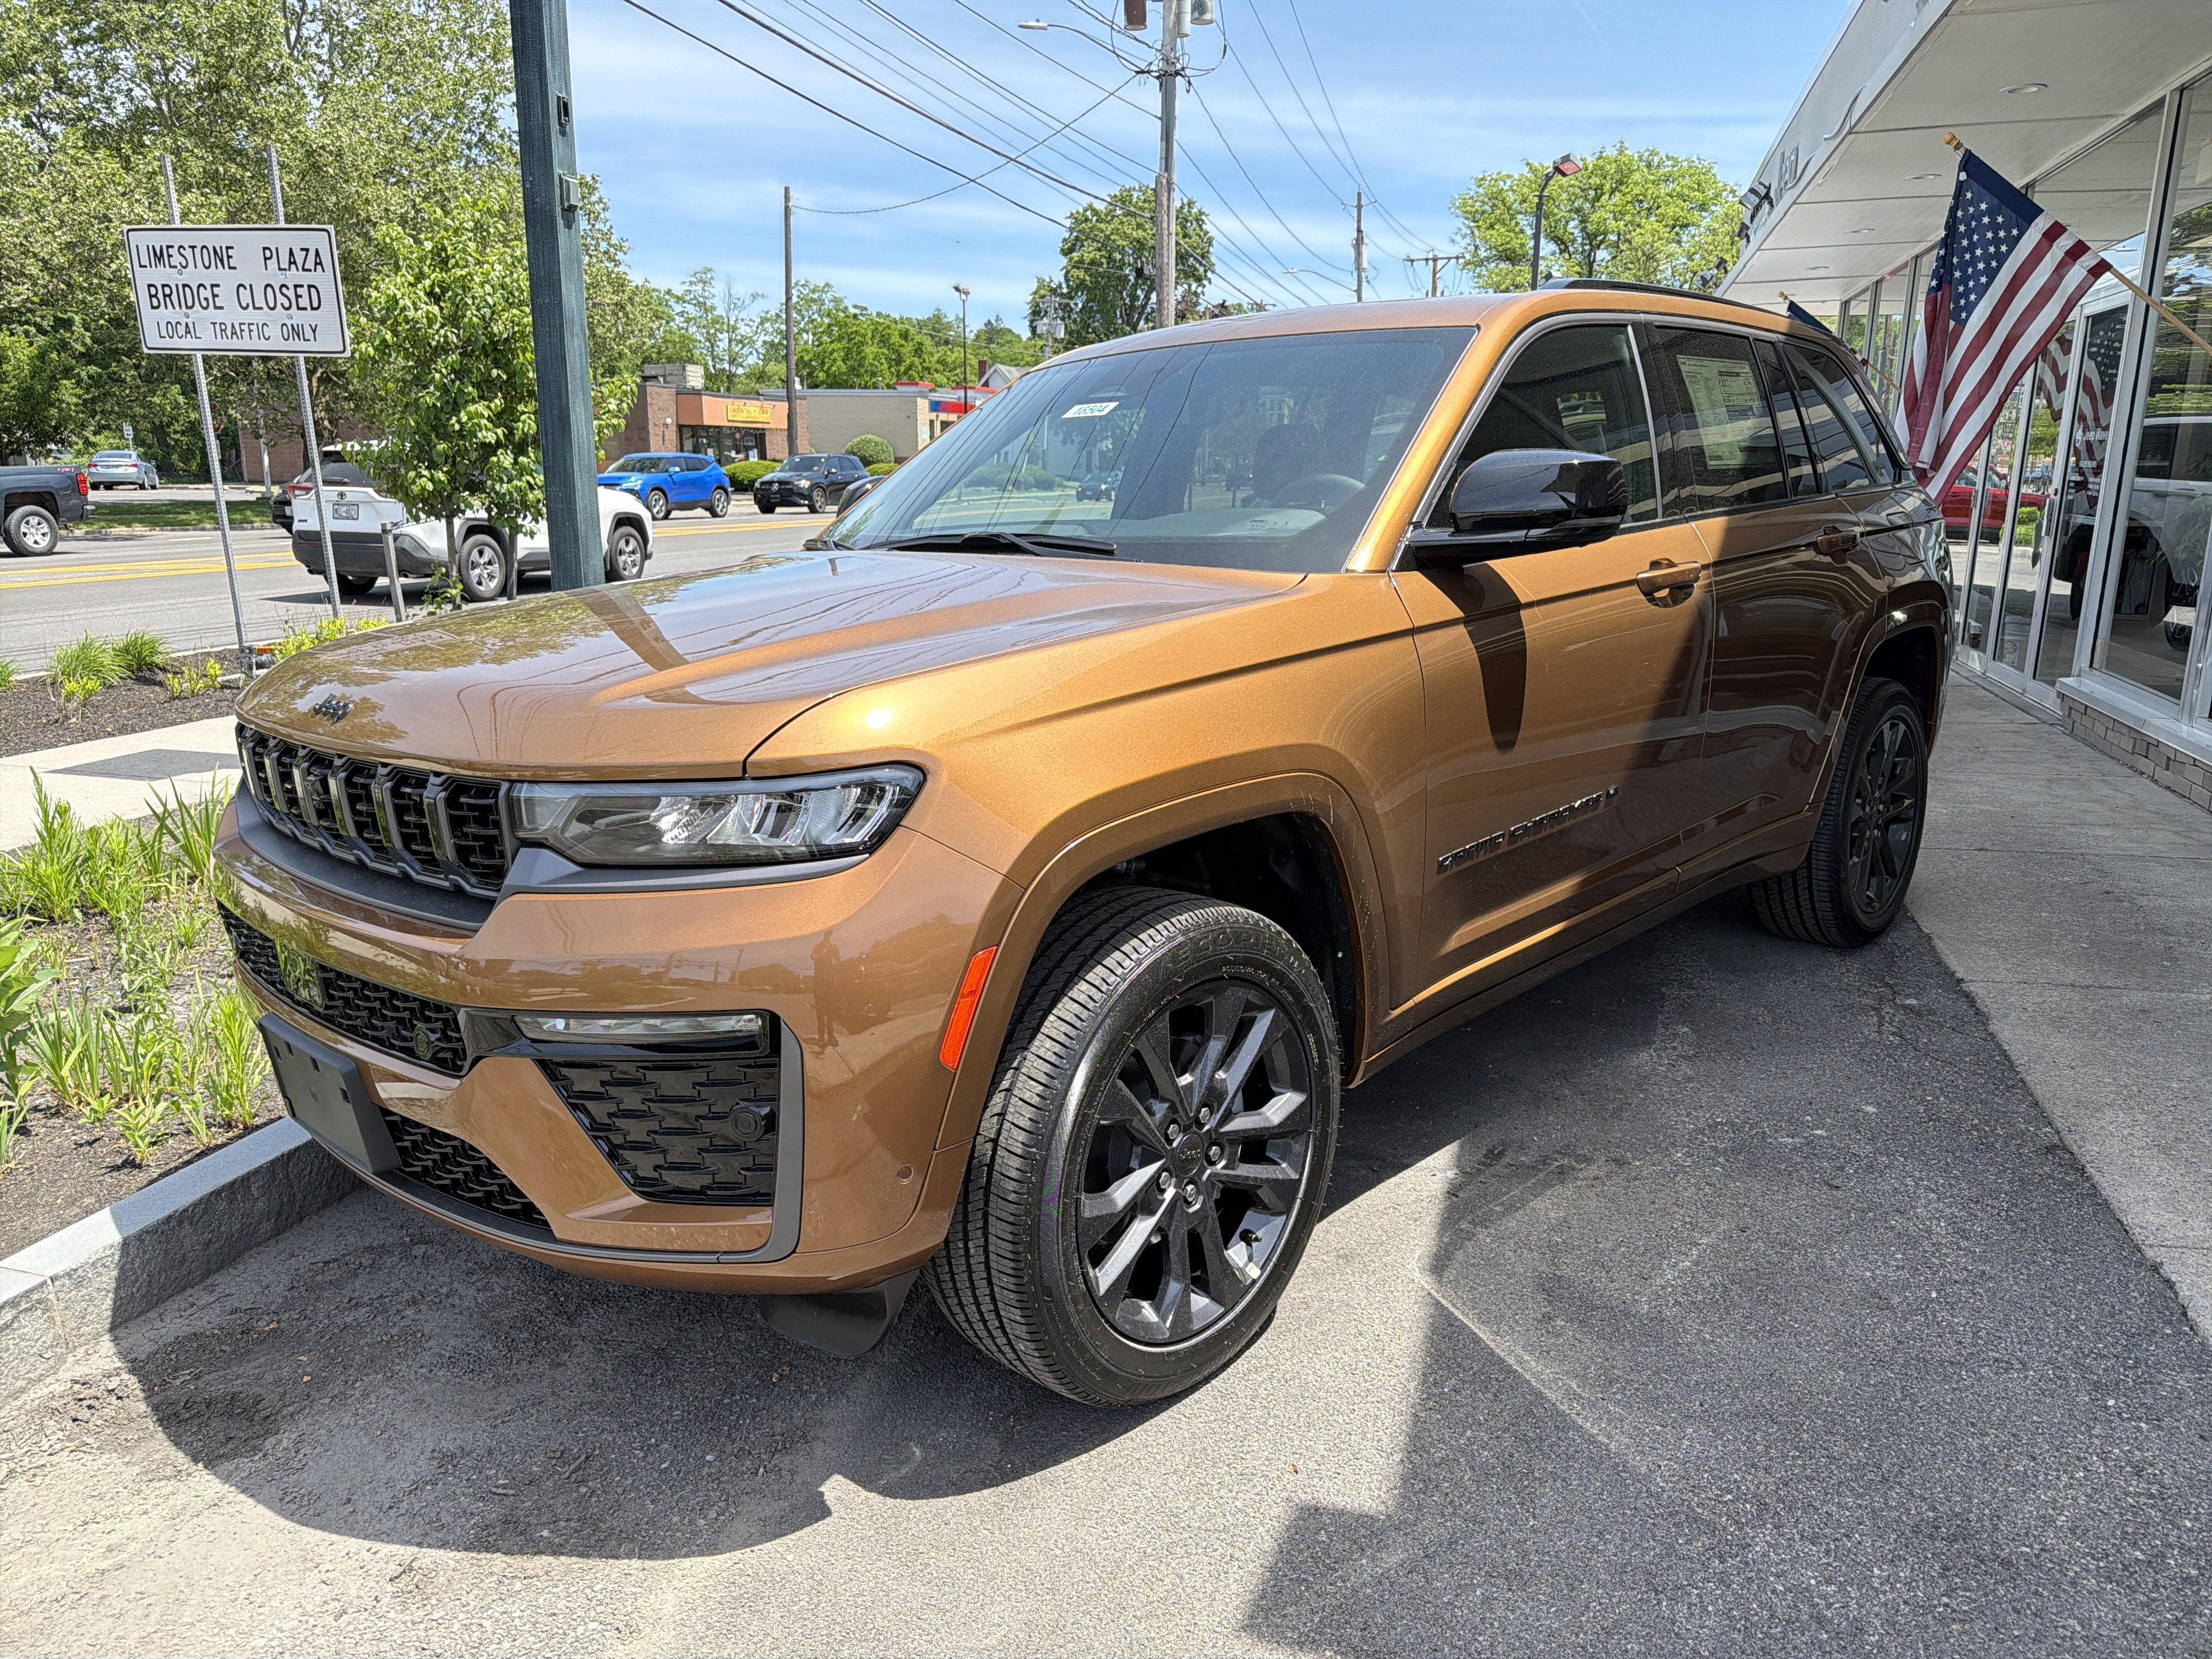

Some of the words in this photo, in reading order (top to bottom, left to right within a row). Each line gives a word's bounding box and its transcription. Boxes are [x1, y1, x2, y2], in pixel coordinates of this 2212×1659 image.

[136, 244, 237, 270] LIMESTONE
[262, 246, 325, 273] PLAZA
[146, 283, 224, 311] BRIDGE
[236, 283, 321, 311] CLOSED
[157, 321, 202, 340] LOCAL
[210, 321, 271, 341] TRAFFIC
[281, 323, 318, 342] ONLY
[2083, 428, 2095, 444] Jeep
